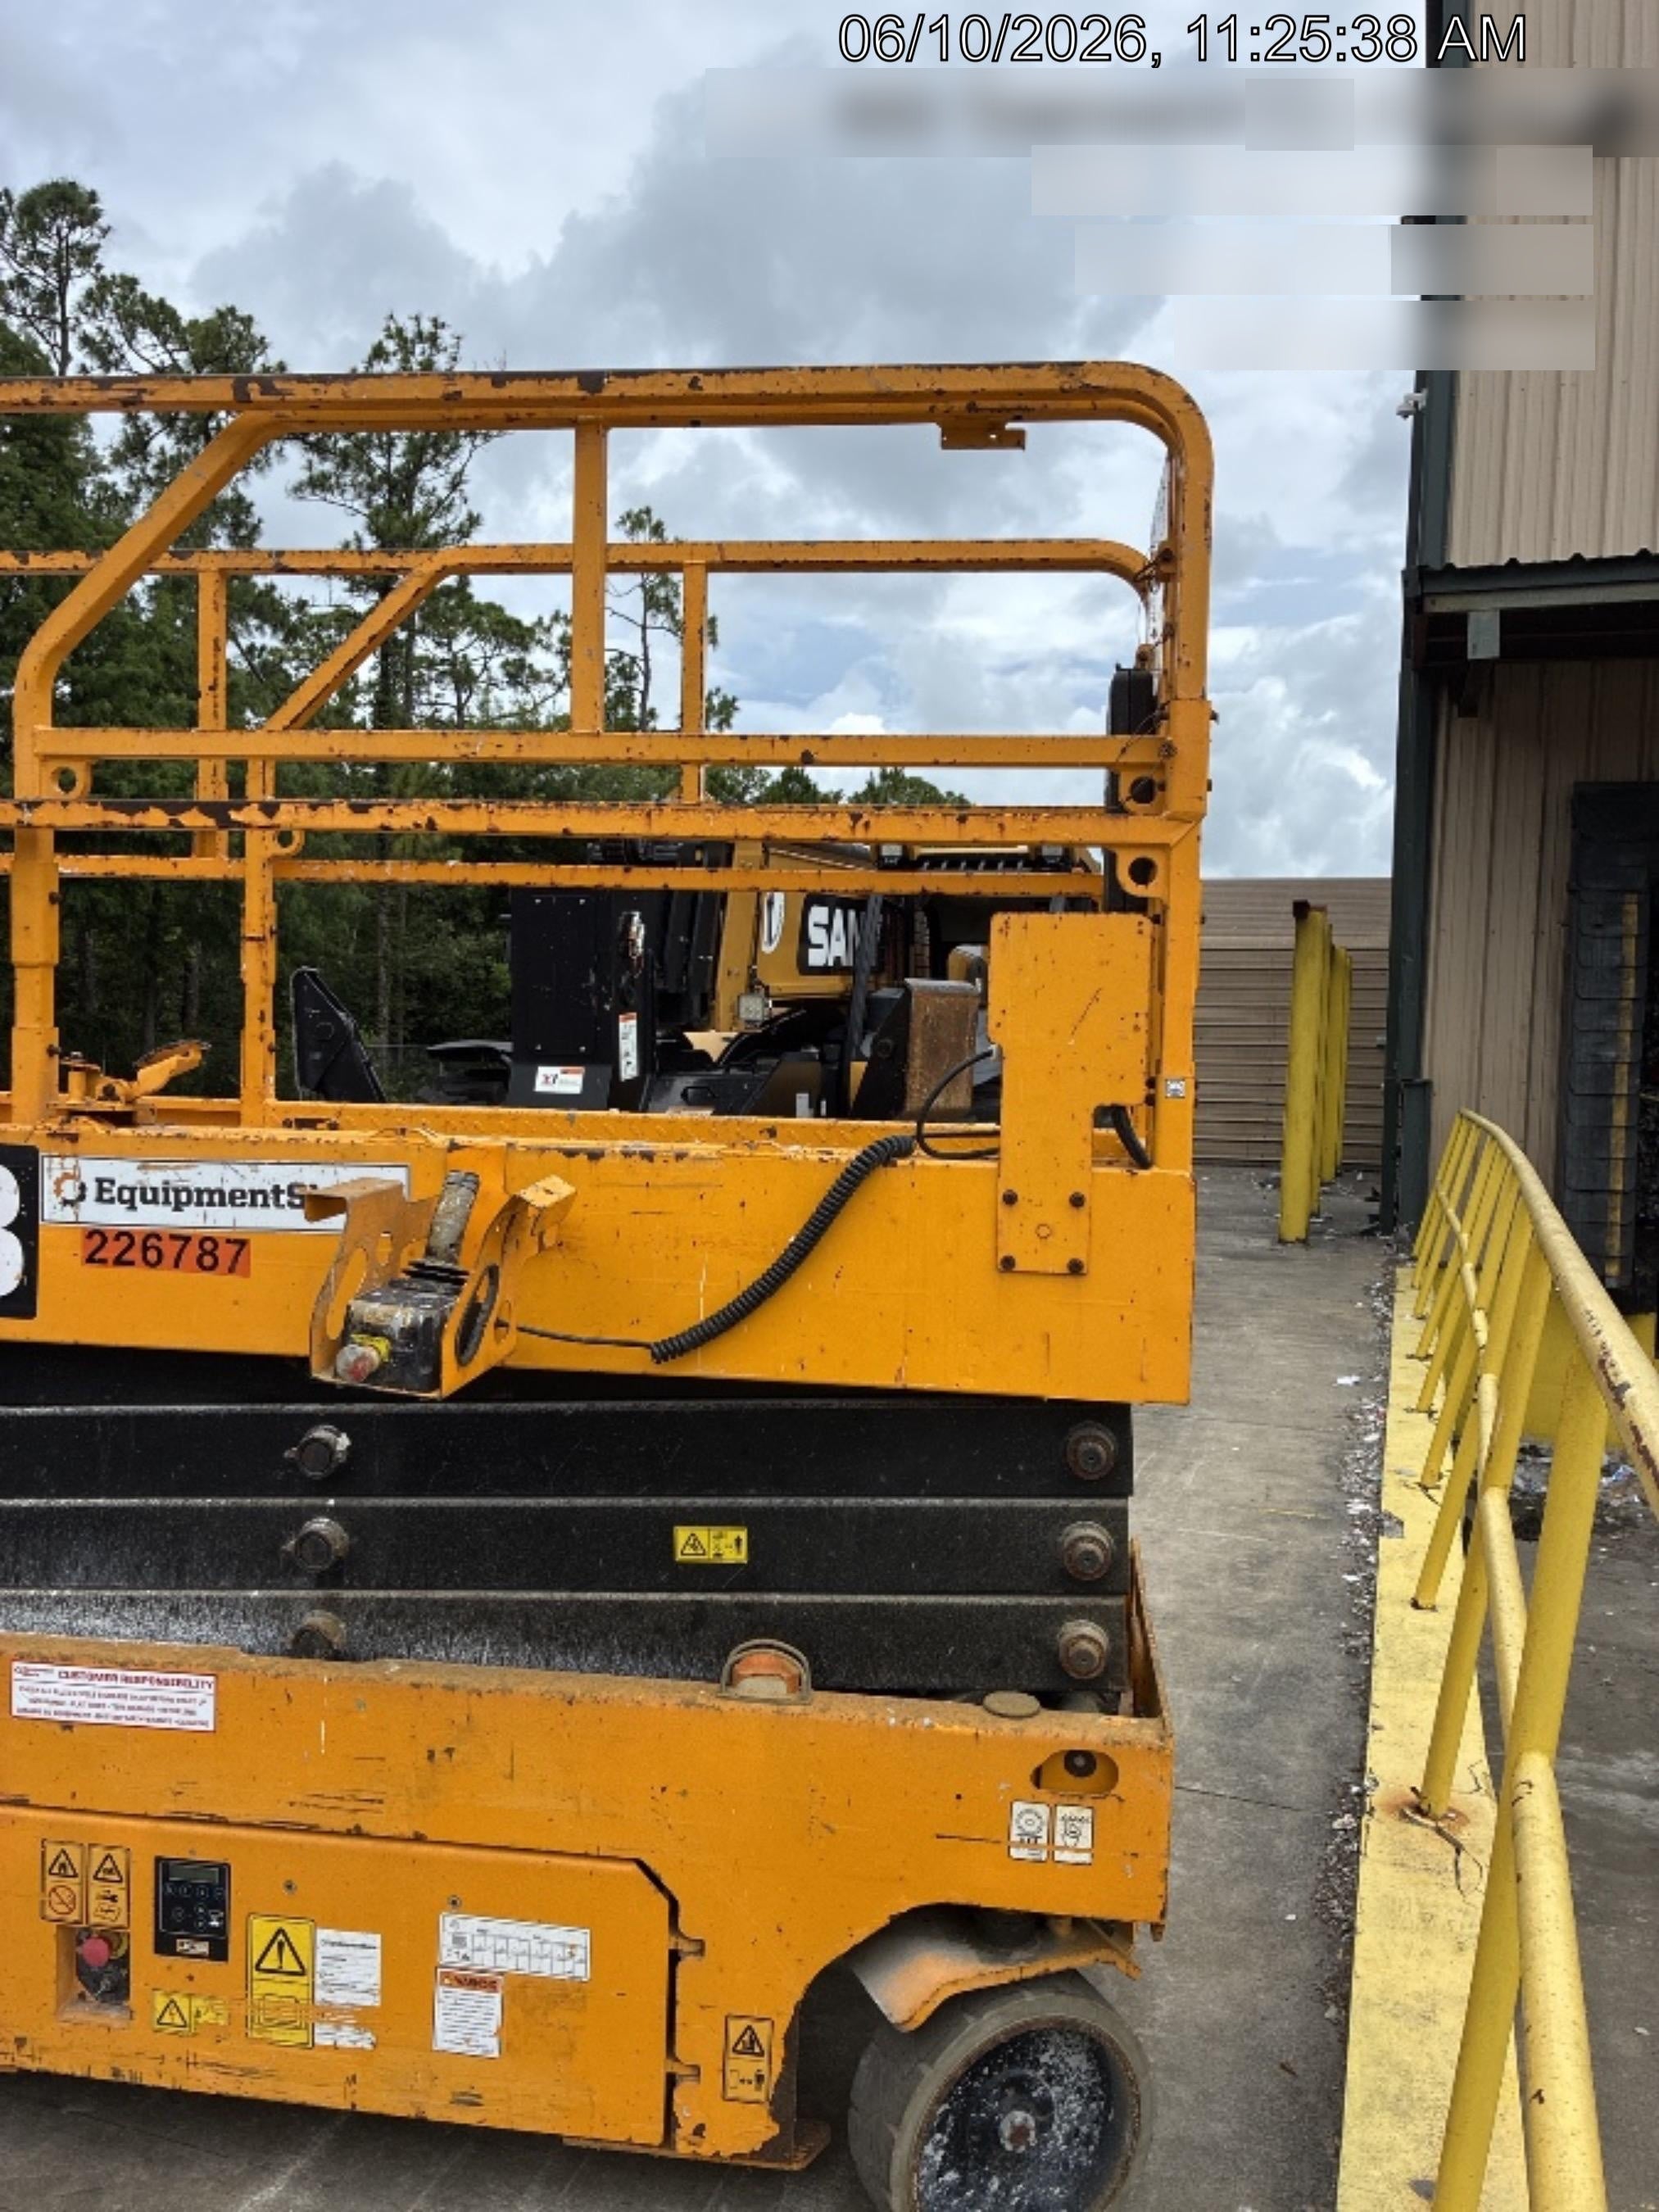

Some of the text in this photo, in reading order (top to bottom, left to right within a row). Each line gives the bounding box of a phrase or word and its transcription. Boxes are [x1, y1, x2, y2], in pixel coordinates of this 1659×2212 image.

[808, 905, 861, 967] SAN
[94, 1176, 318, 1212] EquipmentS
[84, 1229, 249, 1274] 226787
